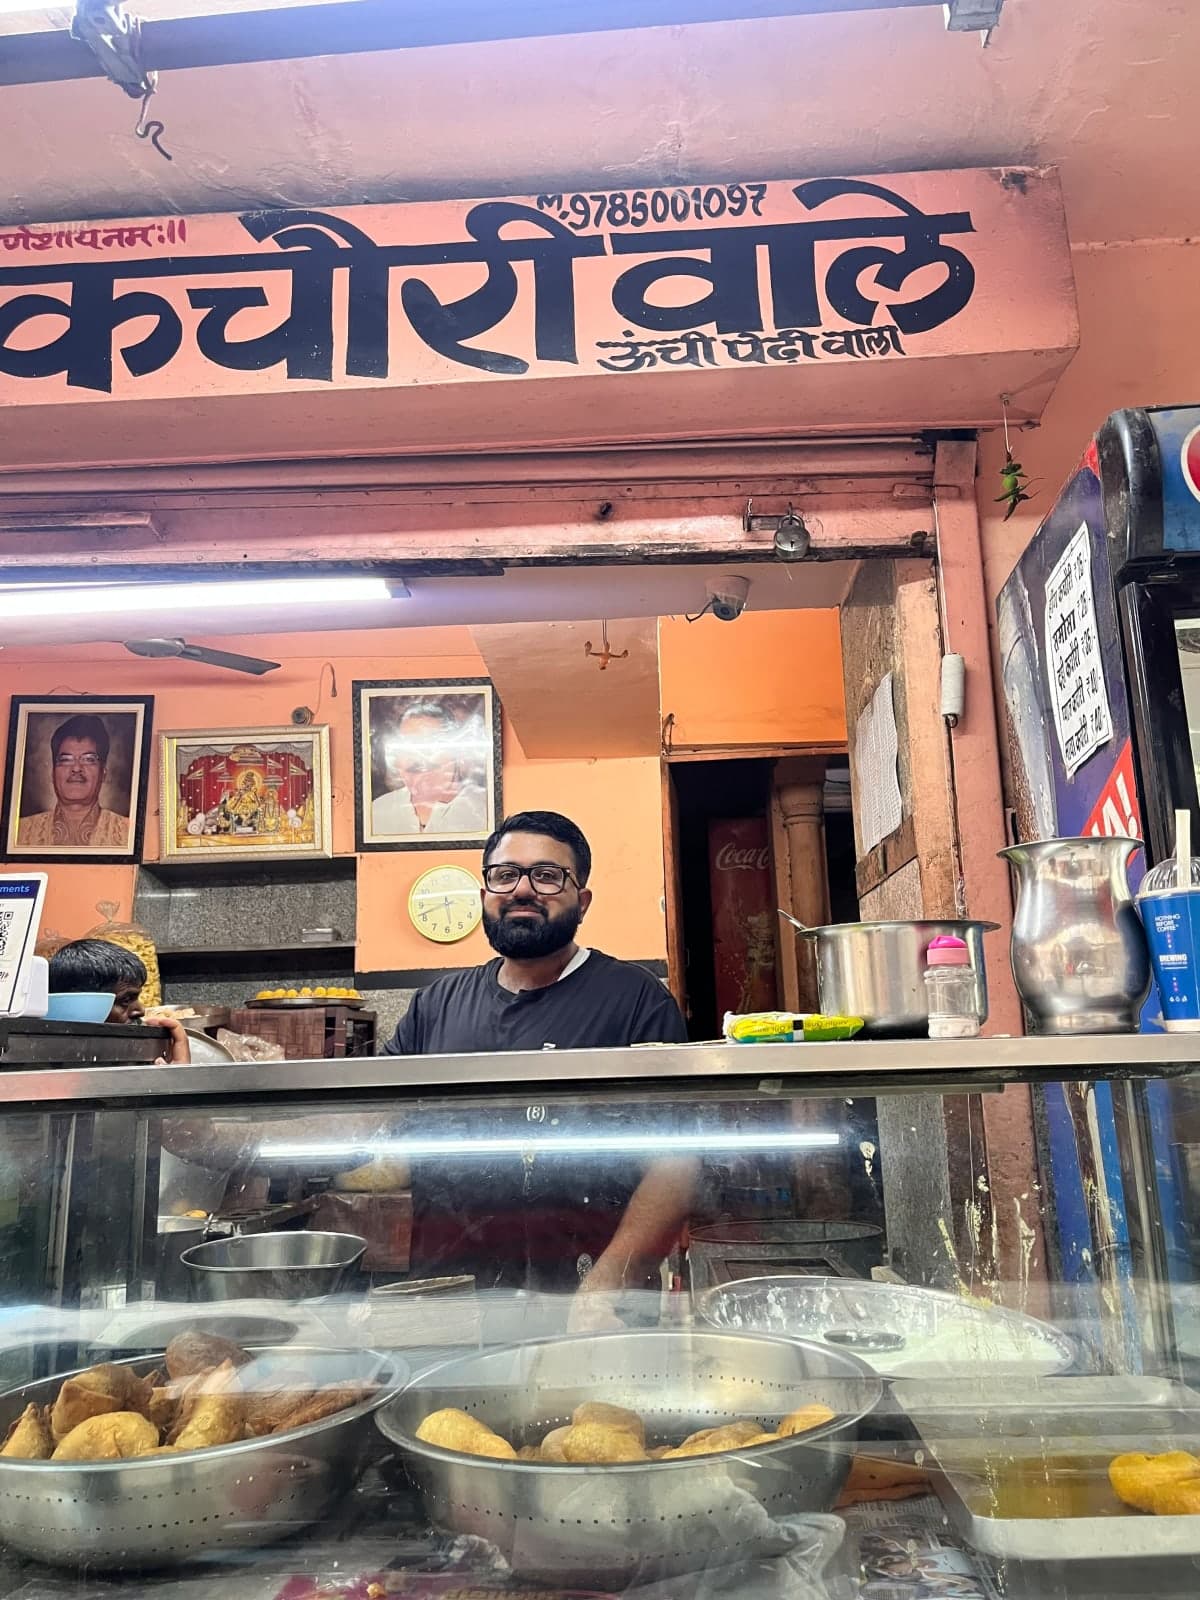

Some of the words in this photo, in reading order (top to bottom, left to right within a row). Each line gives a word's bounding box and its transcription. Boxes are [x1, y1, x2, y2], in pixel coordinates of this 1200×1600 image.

[611, 178, 977, 335] वाले
[822, 325, 907, 358] वाला
[1053, 609, 1076, 652] समोसा
[432, 923, 438, 931] 7
[445, 926, 451, 934] 6
[458, 922, 464, 930] 5
